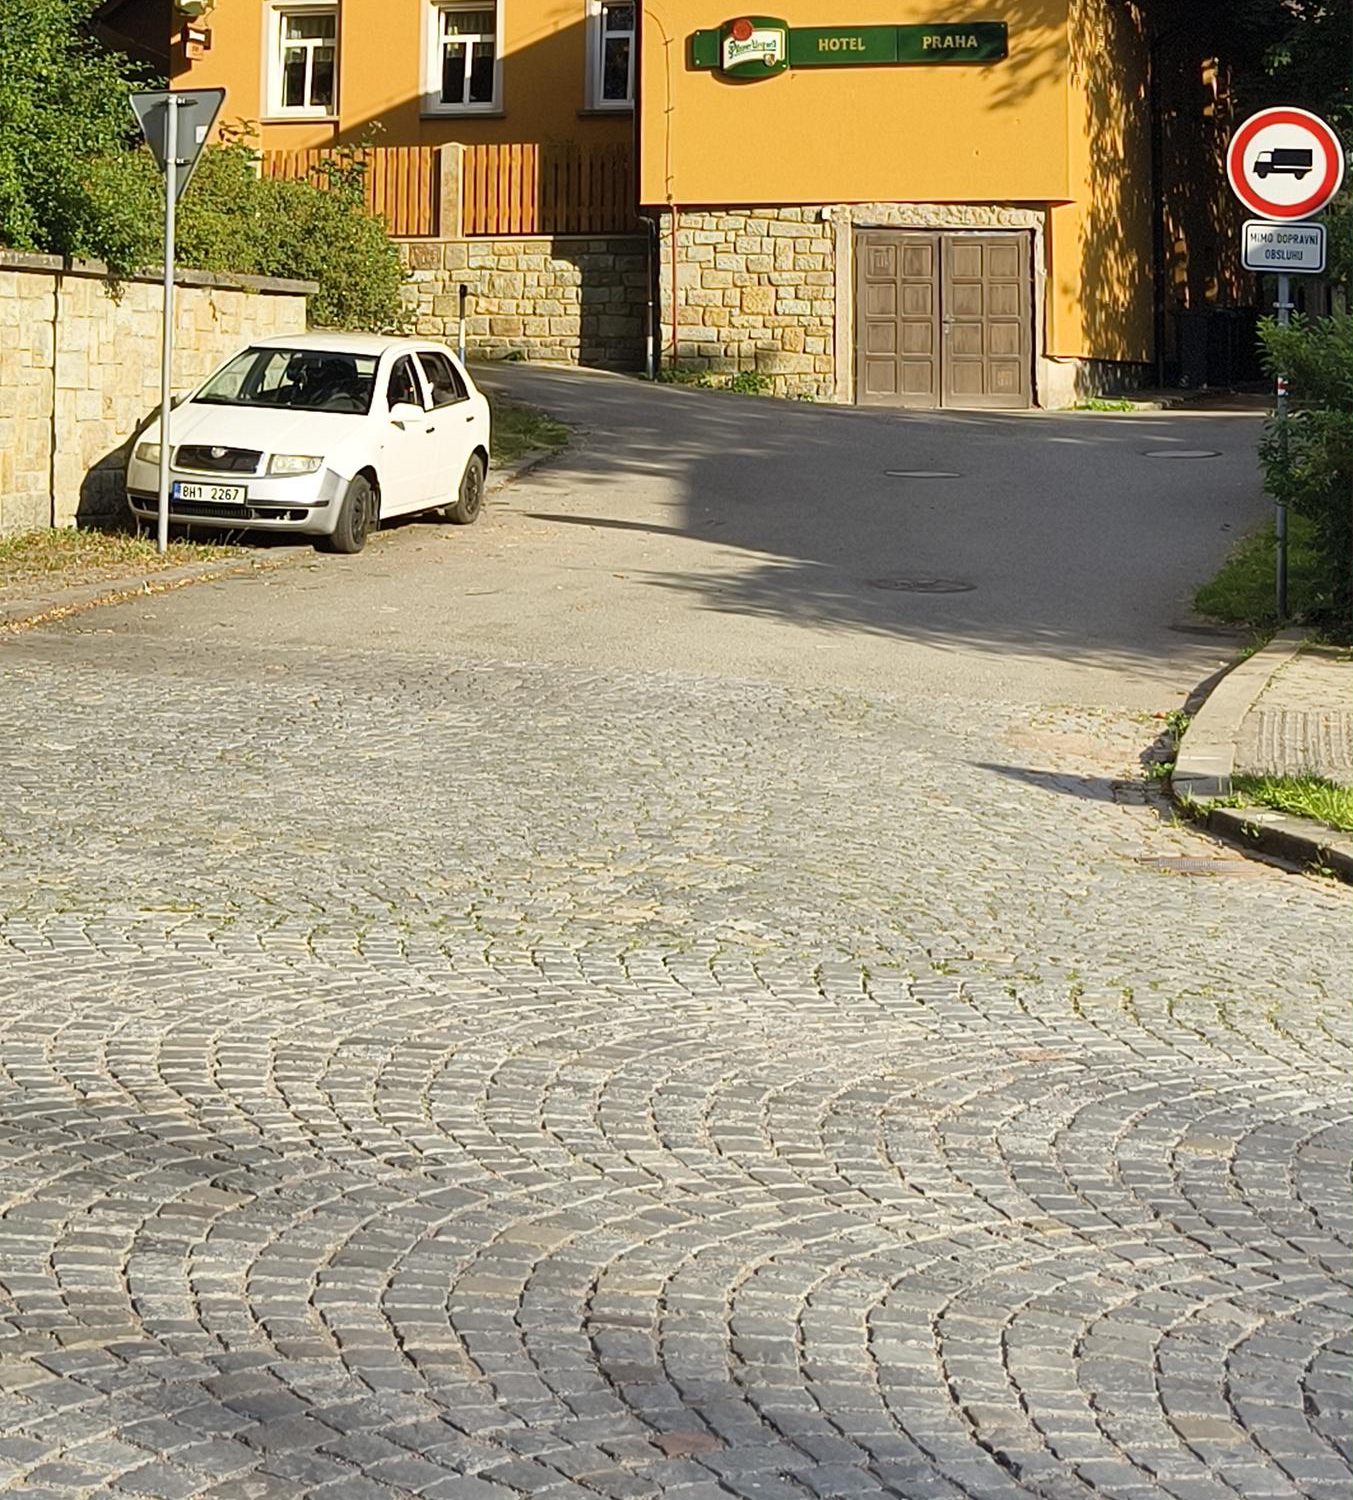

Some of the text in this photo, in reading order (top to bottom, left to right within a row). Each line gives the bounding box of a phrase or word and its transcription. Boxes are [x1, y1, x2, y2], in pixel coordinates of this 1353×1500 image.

[818, 35, 977, 51] HOTEL PRAHA
[1250, 232, 1273, 243] MIMO
[1264, 249, 1303, 260] OBSLUHU
[210, 487, 239, 501] 2267
